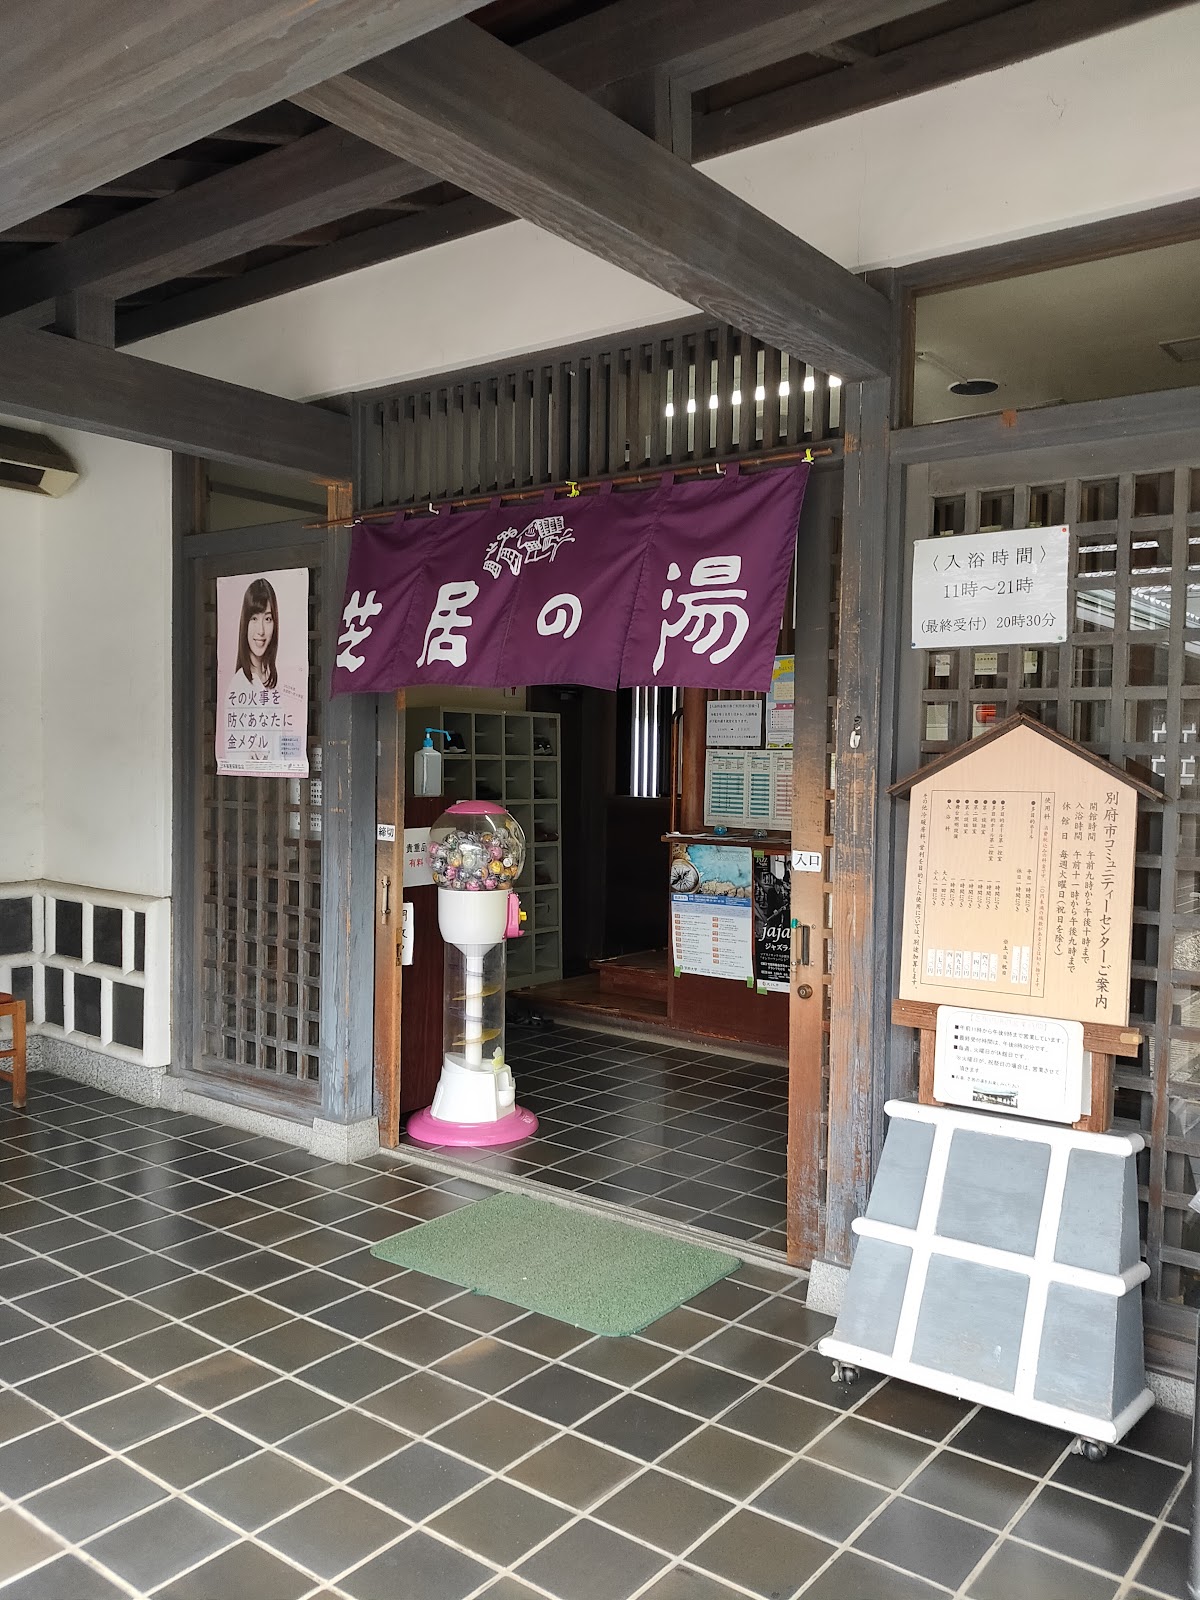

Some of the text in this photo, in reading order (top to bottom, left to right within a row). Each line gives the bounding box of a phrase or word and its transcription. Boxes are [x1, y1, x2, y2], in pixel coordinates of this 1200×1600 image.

[336, 555, 751, 677] 芝居の湯
[228, 690, 281, 706] その火事を
[227, 712, 293, 728] 防ぐあなたに
[794, 853, 820, 867] 入口
[1095, 791, 1120, 1009] 別府市コミュニティーセンターご案内
[765, 943, 791, 952] ジャズラ
